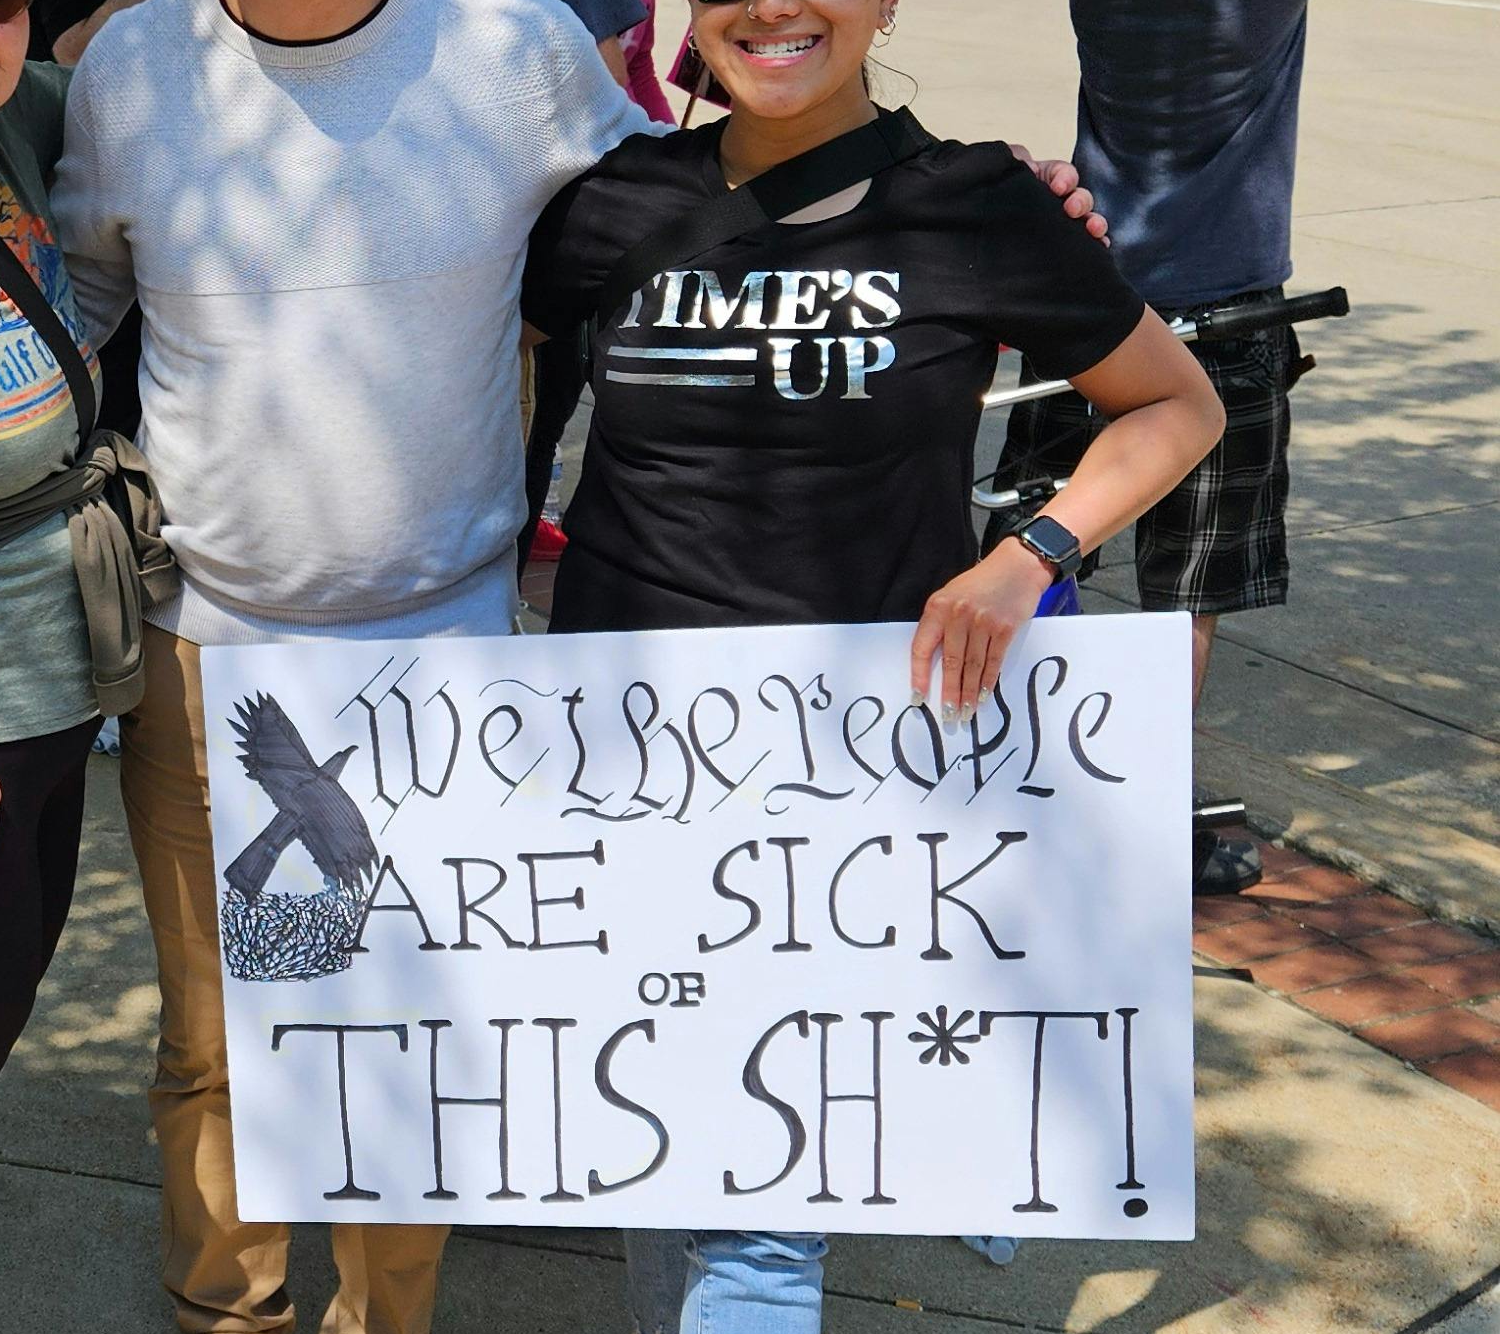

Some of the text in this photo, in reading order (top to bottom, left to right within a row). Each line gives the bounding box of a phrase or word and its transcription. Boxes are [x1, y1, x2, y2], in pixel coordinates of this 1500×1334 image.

[767, 335, 896, 401] UP
[345, 831, 1027, 961] ARE SICK
[638, 972, 706, 1007] OF
[272, 1018, 671, 1201] THIS
